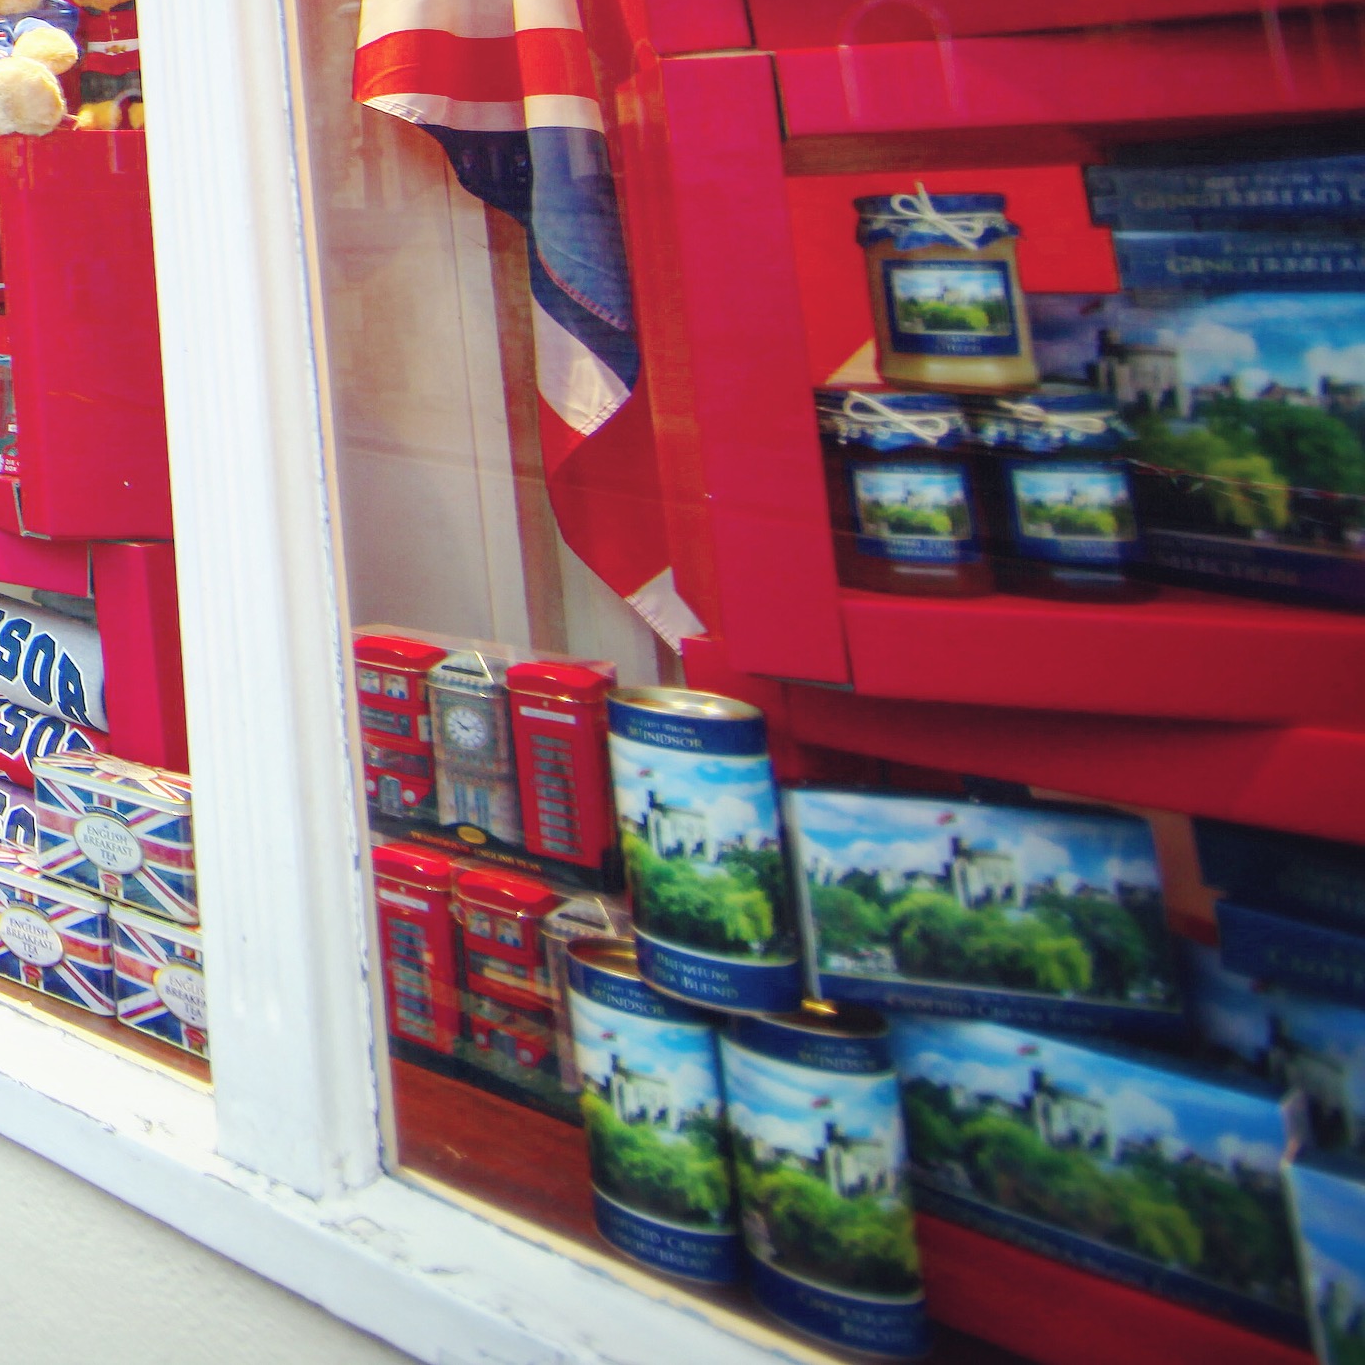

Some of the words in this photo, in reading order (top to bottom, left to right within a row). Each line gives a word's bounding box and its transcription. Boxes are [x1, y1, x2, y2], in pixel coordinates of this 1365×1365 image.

[628, 724, 703, 750] WINDSOR
[83, 833, 133, 857] BREAKFAST
[87, 824, 128, 846] ENGLISH
[100, 848, 118, 863] TEA
[5, 926, 53, 951] BREAKFAST
[9, 917, 49, 939] ENGLISH
[22, 941, 39, 956] TEA
[165, 984, 207, 1007] BREAKF
[169, 974, 205, 996] ENGLIS
[185, 1002, 203, 1019] TEA
[591, 985, 667, 1017] WINDSOR
